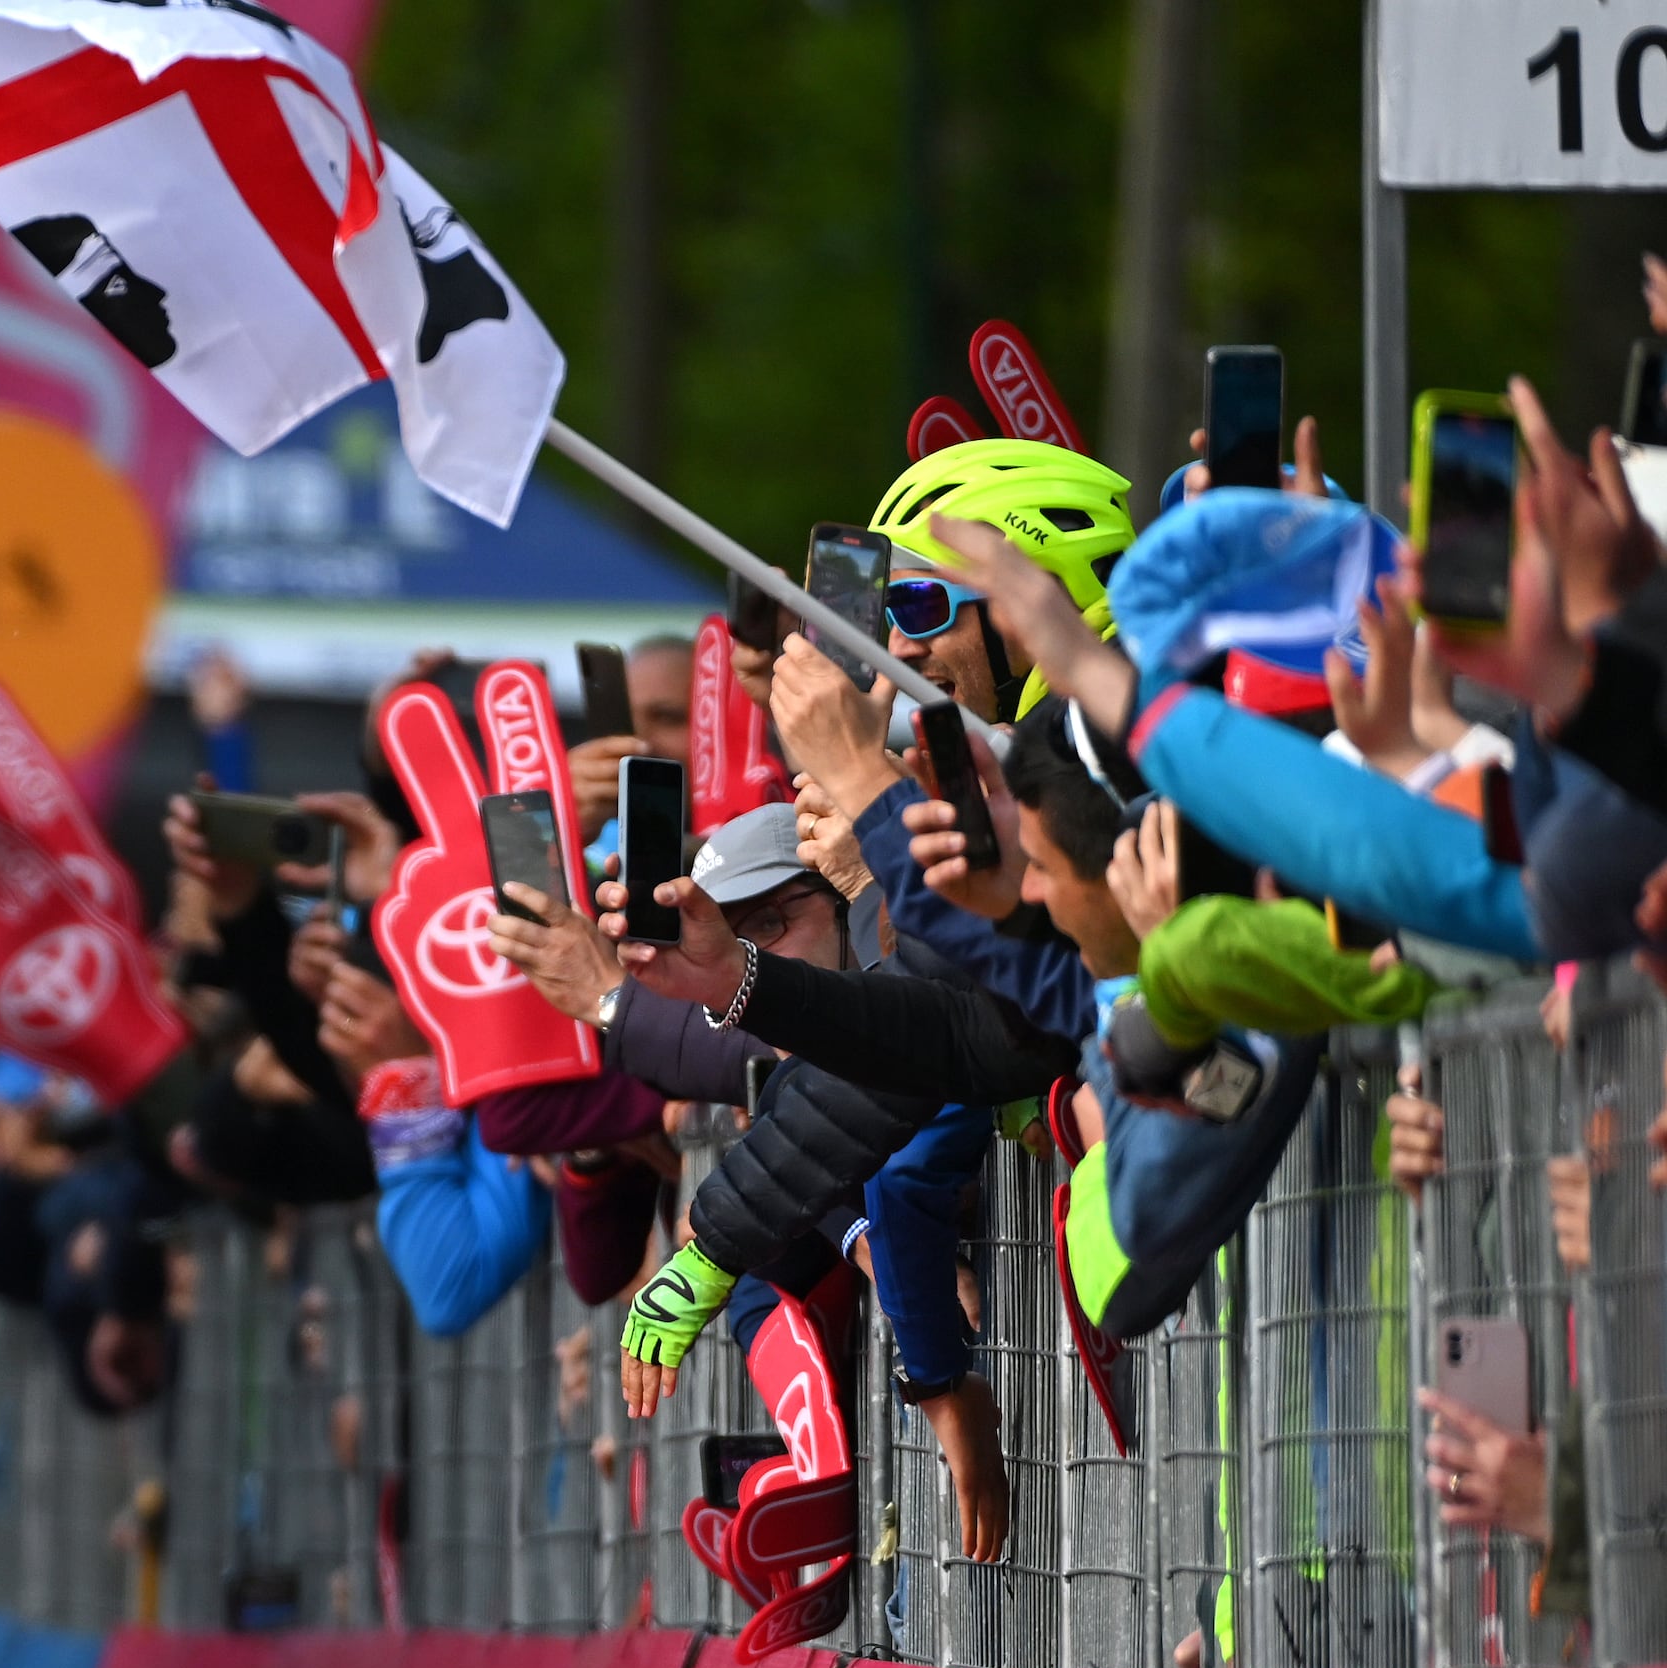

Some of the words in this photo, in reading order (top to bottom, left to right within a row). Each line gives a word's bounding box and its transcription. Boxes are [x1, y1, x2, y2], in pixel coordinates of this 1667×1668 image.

[993, 348, 1057, 443] OTA
[1004, 511, 1049, 545] KASK
[494, 684, 547, 794] YOTA
